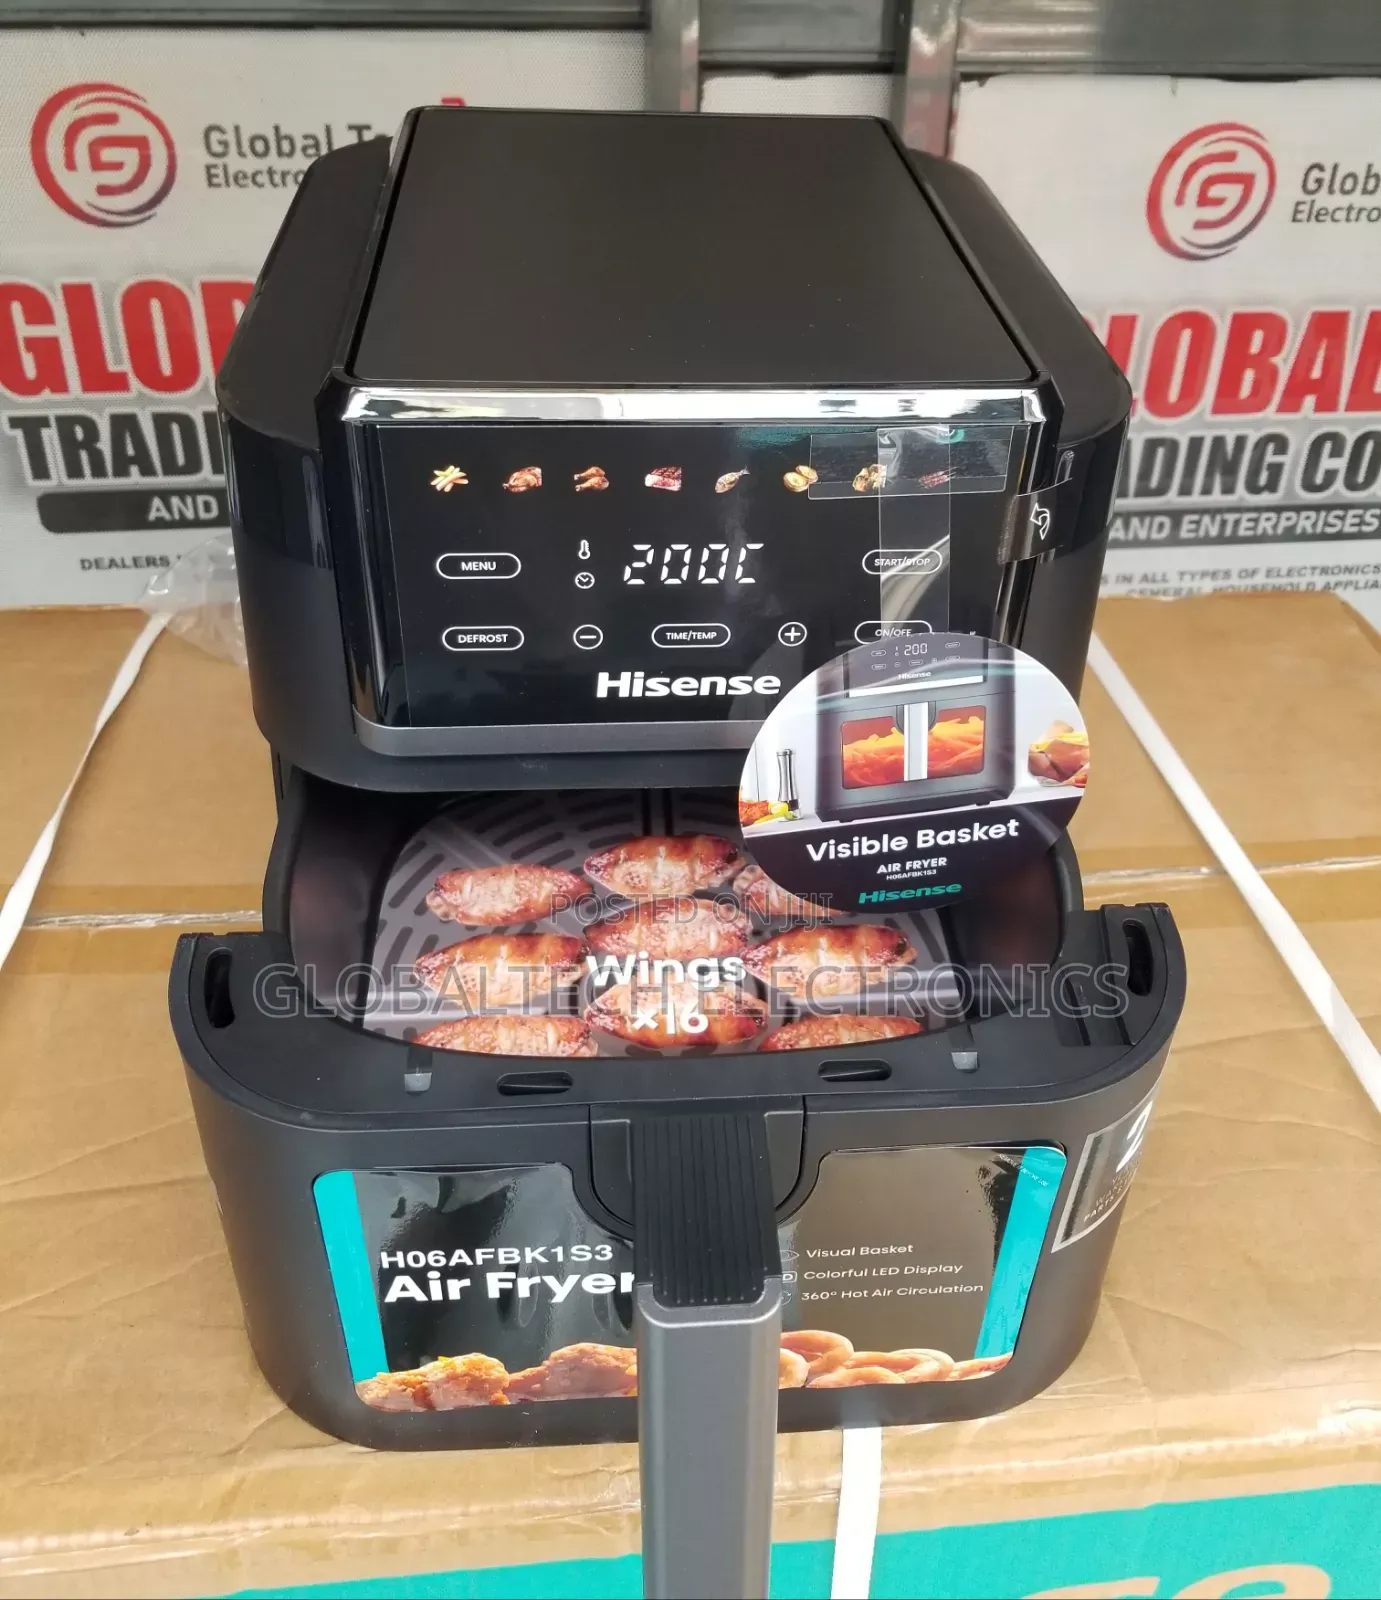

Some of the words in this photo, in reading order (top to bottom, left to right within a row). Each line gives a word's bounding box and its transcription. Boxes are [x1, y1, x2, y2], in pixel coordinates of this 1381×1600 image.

[203, 123, 334, 159] Global
[148, 495, 219, 521] AND
[1108, 514, 1171, 541] AND
[1179, 509, 1381, 538] ENTERPRISES
[79, 555, 171, 571] DEALERS
[461, 560, 497, 571] MENU
[874, 555, 931, 568] START/STOP
[1115, 573, 1133, 584] IN
[1139, 572, 1169, 584] ALL
[1177, 569, 1232, 583] TYPES
[1237, 567, 1261, 580] OF
[1265, 563, 1381, 579] ELECTRONICS
[457, 632, 509, 644] DEFROST
[665, 630, 718, 641] TIME/TEMP
[596, 671, 782, 698] Hisense
[806, 833, 909, 862] Visible
[916, 818, 1020, 849] Basket
[876, 862, 901, 875] AIR
[905, 856, 948, 871] FRYER
[858, 882, 963, 904] Hisense
[585, 950, 747, 992] Wings
[380, 1244, 614, 1269] H06AFBK1S3
[805, 1247, 856, 1259] Visual
[859, 1244, 914, 1256] Basket
[803, 1267, 868, 1280] Colorful
[872, 1267, 900, 1276] LED
[903, 1264, 964, 1276] Display
[384, 1270, 471, 1303] Air
[485, 1270, 635, 1304] Fryer
[841, 1289, 869, 1299] Hot
[871, 1287, 894, 1298] Air
[896, 1283, 985, 1297] Circulation
